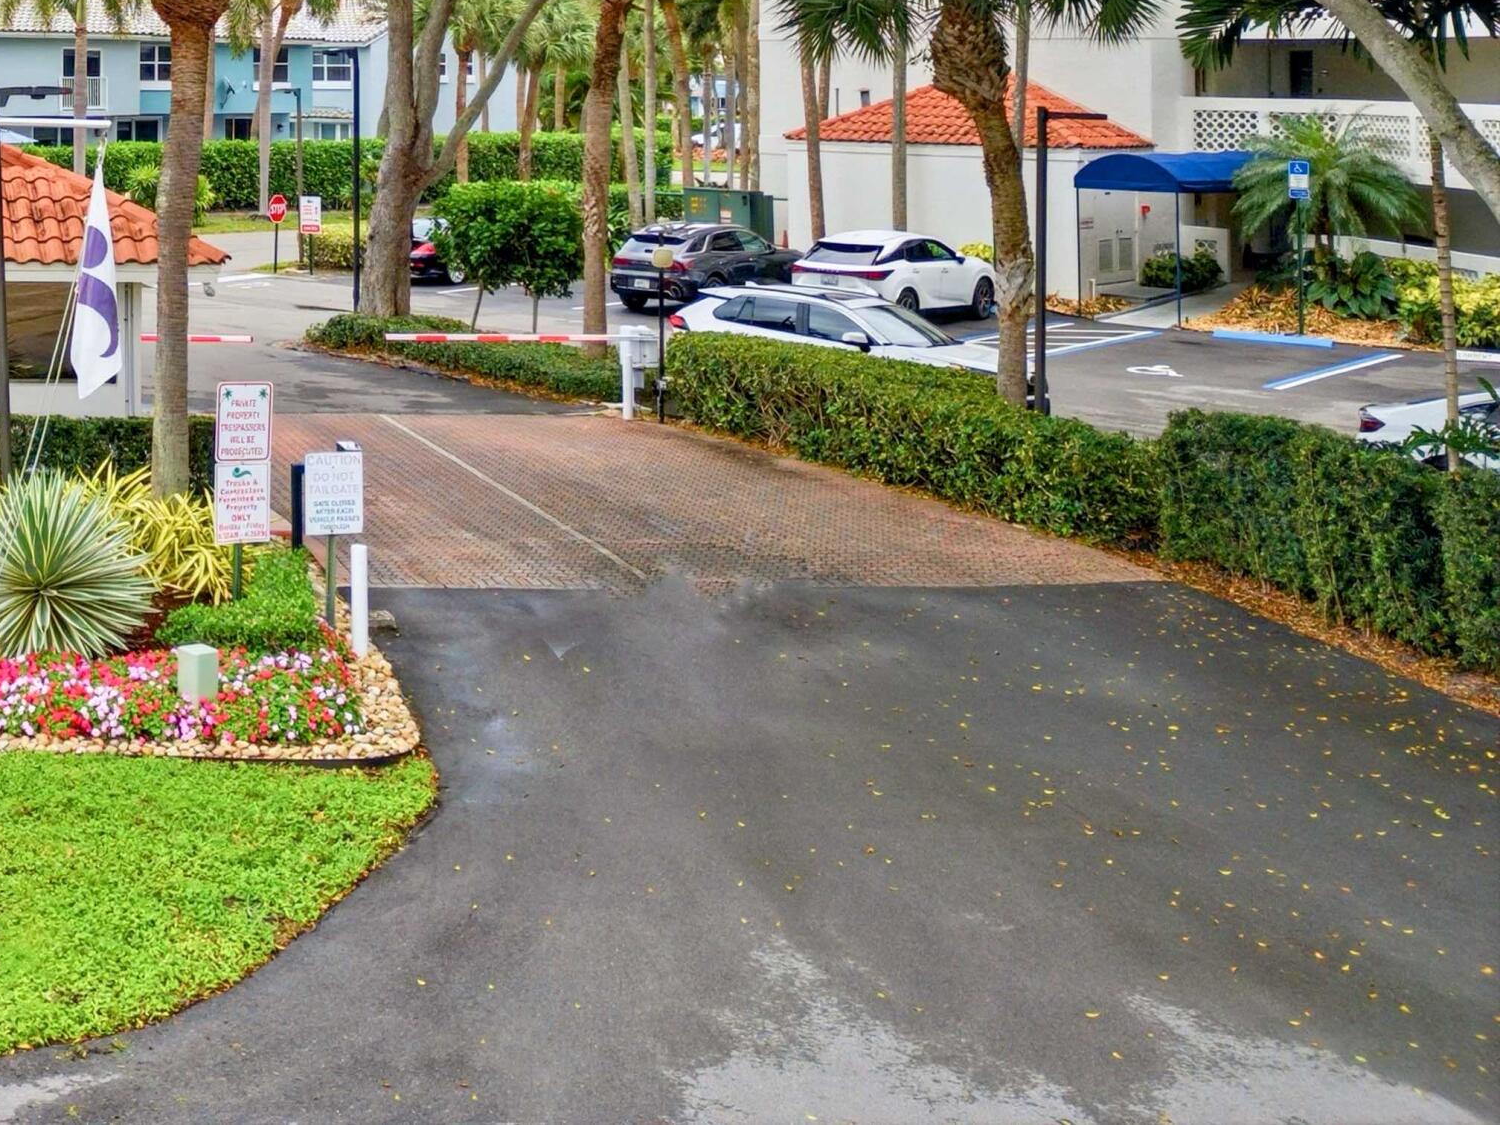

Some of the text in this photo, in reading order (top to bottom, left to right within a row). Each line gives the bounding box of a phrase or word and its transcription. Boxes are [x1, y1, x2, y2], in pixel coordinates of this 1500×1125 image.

[269, 204, 286, 215] STOP
[231, 399, 257, 407] PRIVATE
[227, 411, 260, 419] PROPERTY
[220, 423, 266, 432] TRESPASSERS
[230, 435, 255, 444] WILL BE
[220, 447, 263, 456] PROSECUTED
[307, 454, 360, 466] CAUTION
[313, 472, 354, 482] DO NOT
[309, 484, 359, 495] TAILGATE
[231, 514, 251, 522] ONLY
